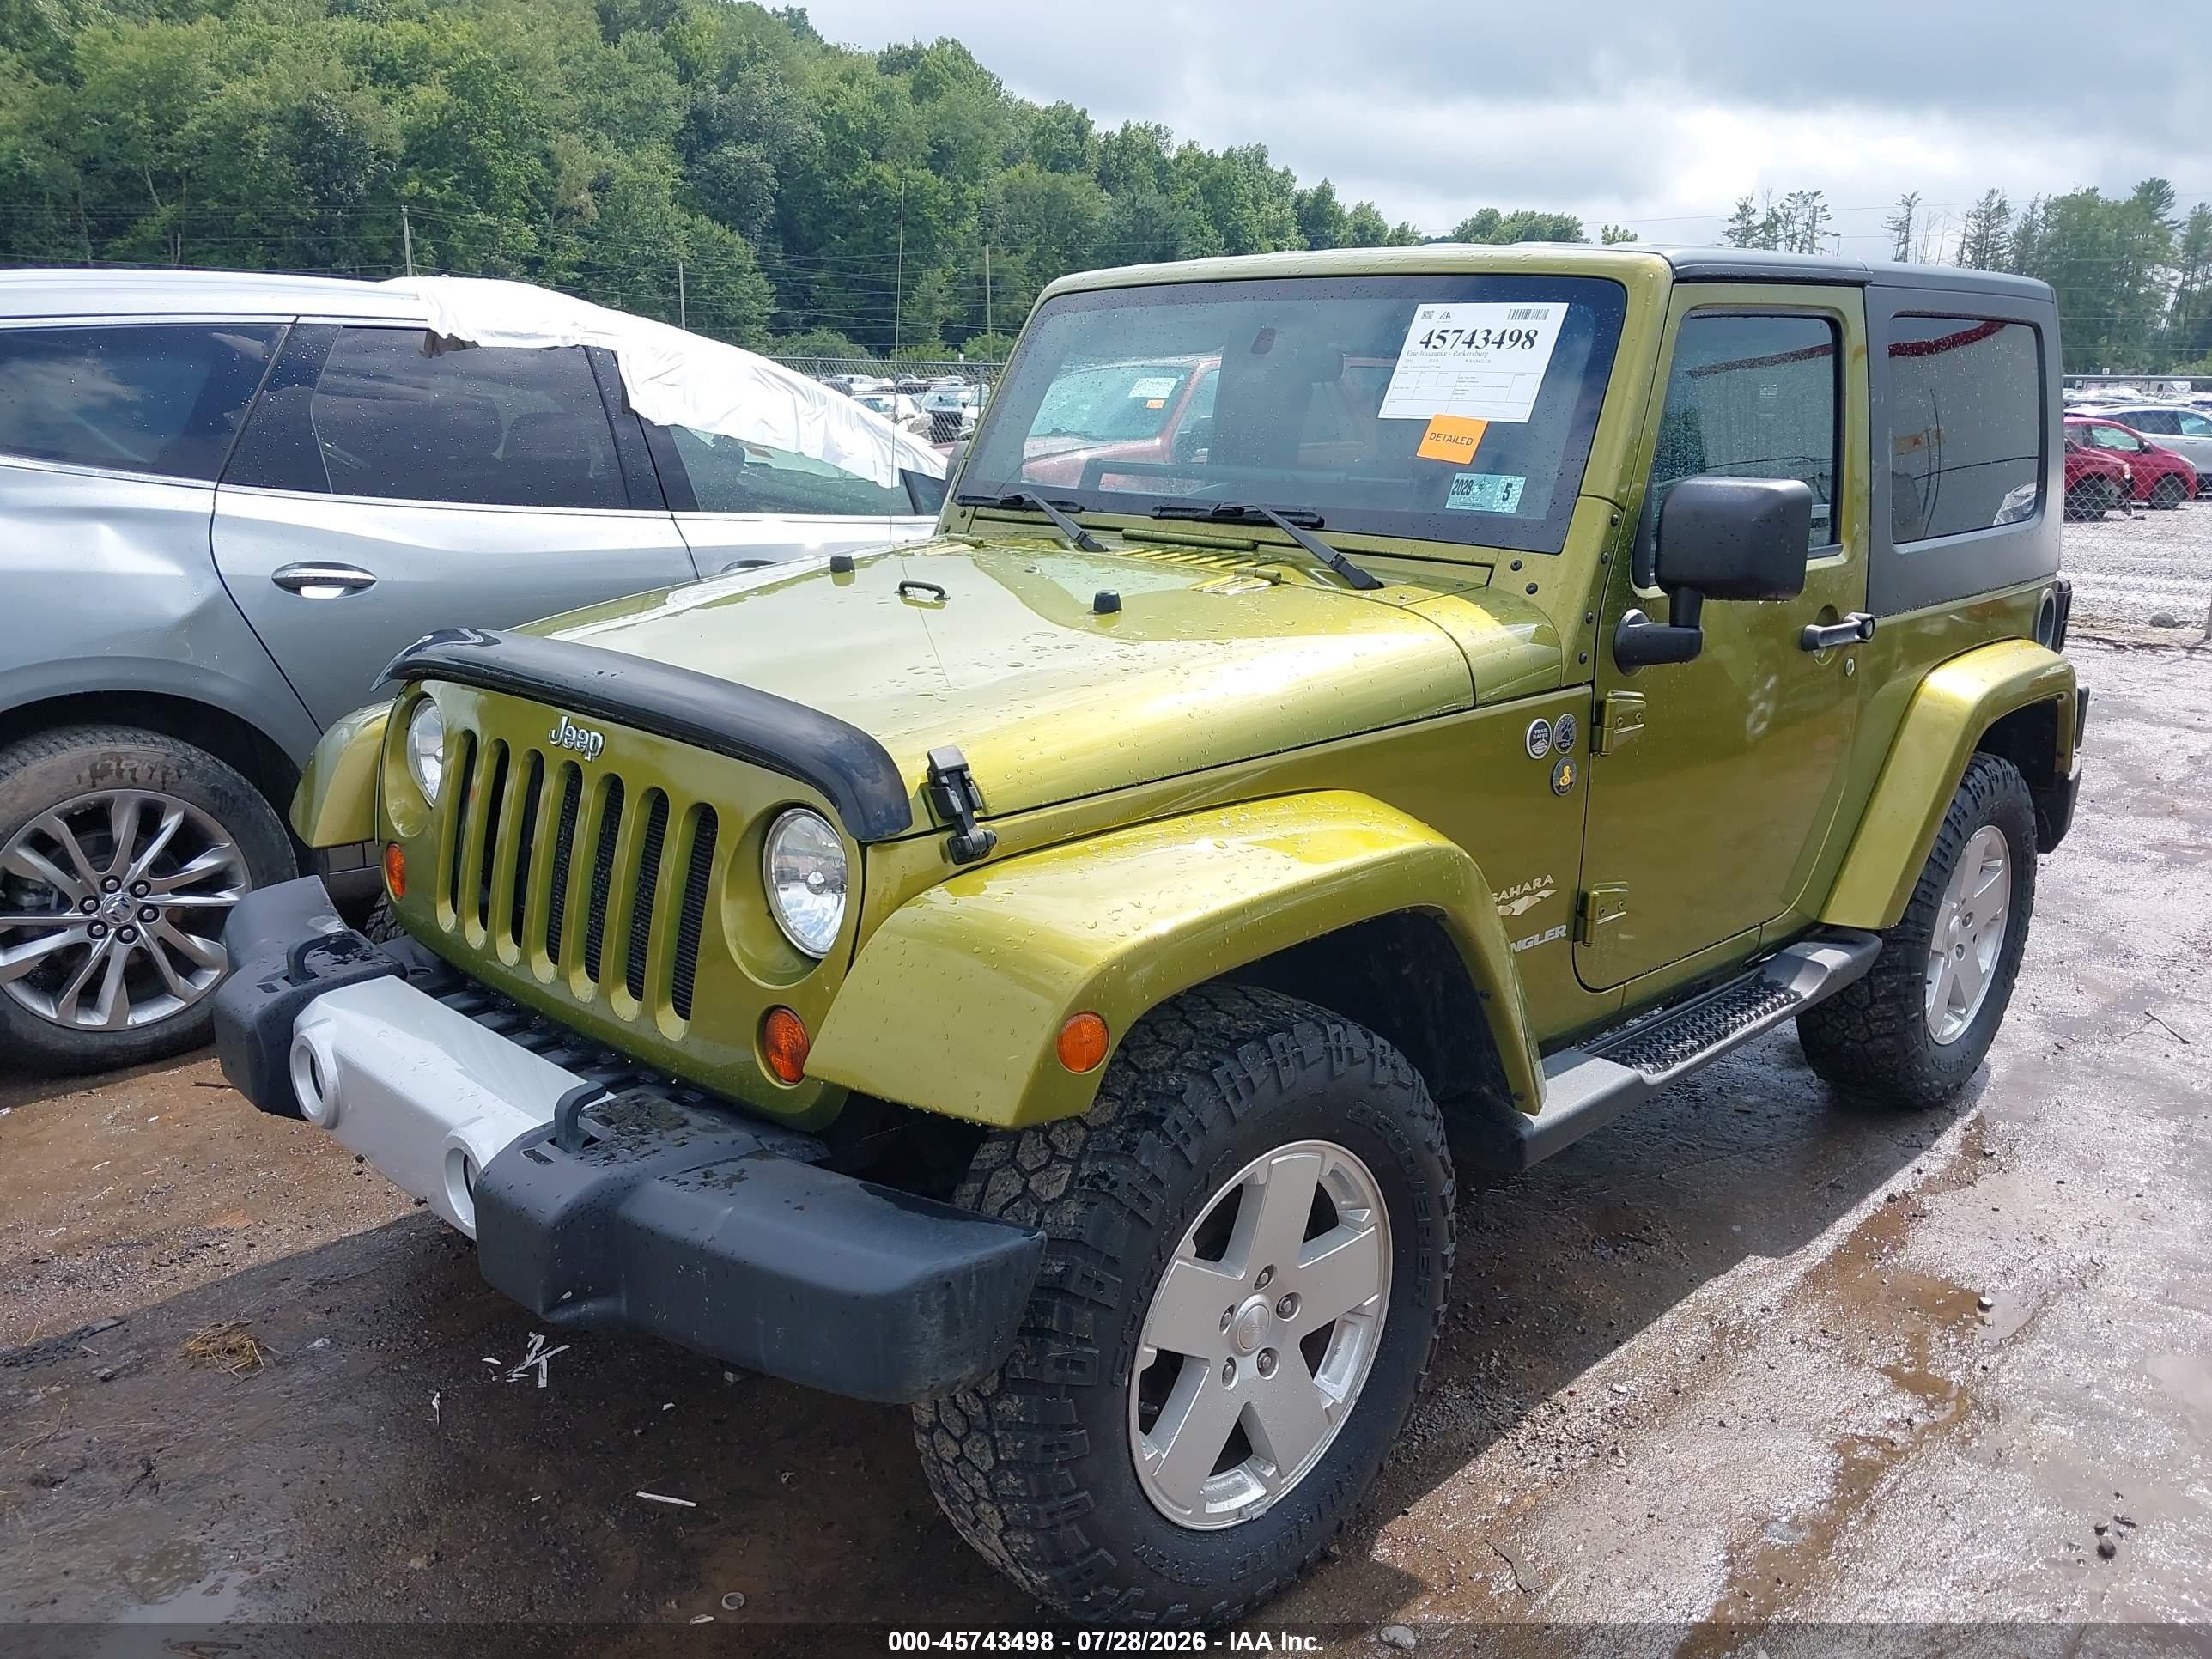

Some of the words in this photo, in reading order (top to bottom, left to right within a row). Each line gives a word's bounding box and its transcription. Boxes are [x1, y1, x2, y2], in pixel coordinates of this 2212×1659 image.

[1419, 329, 1539, 350] 45743498
[1453, 350, 1489, 359] Parkersburg
[1429, 432, 1474, 446] DETAILED
[1451, 478, 1474, 496] 2028
[1502, 483, 1513, 502] 5
[549, 715, 605, 762] Jeep
[1492, 874, 1553, 902] SAHARA
[1510, 924, 1567, 952] NGLER
